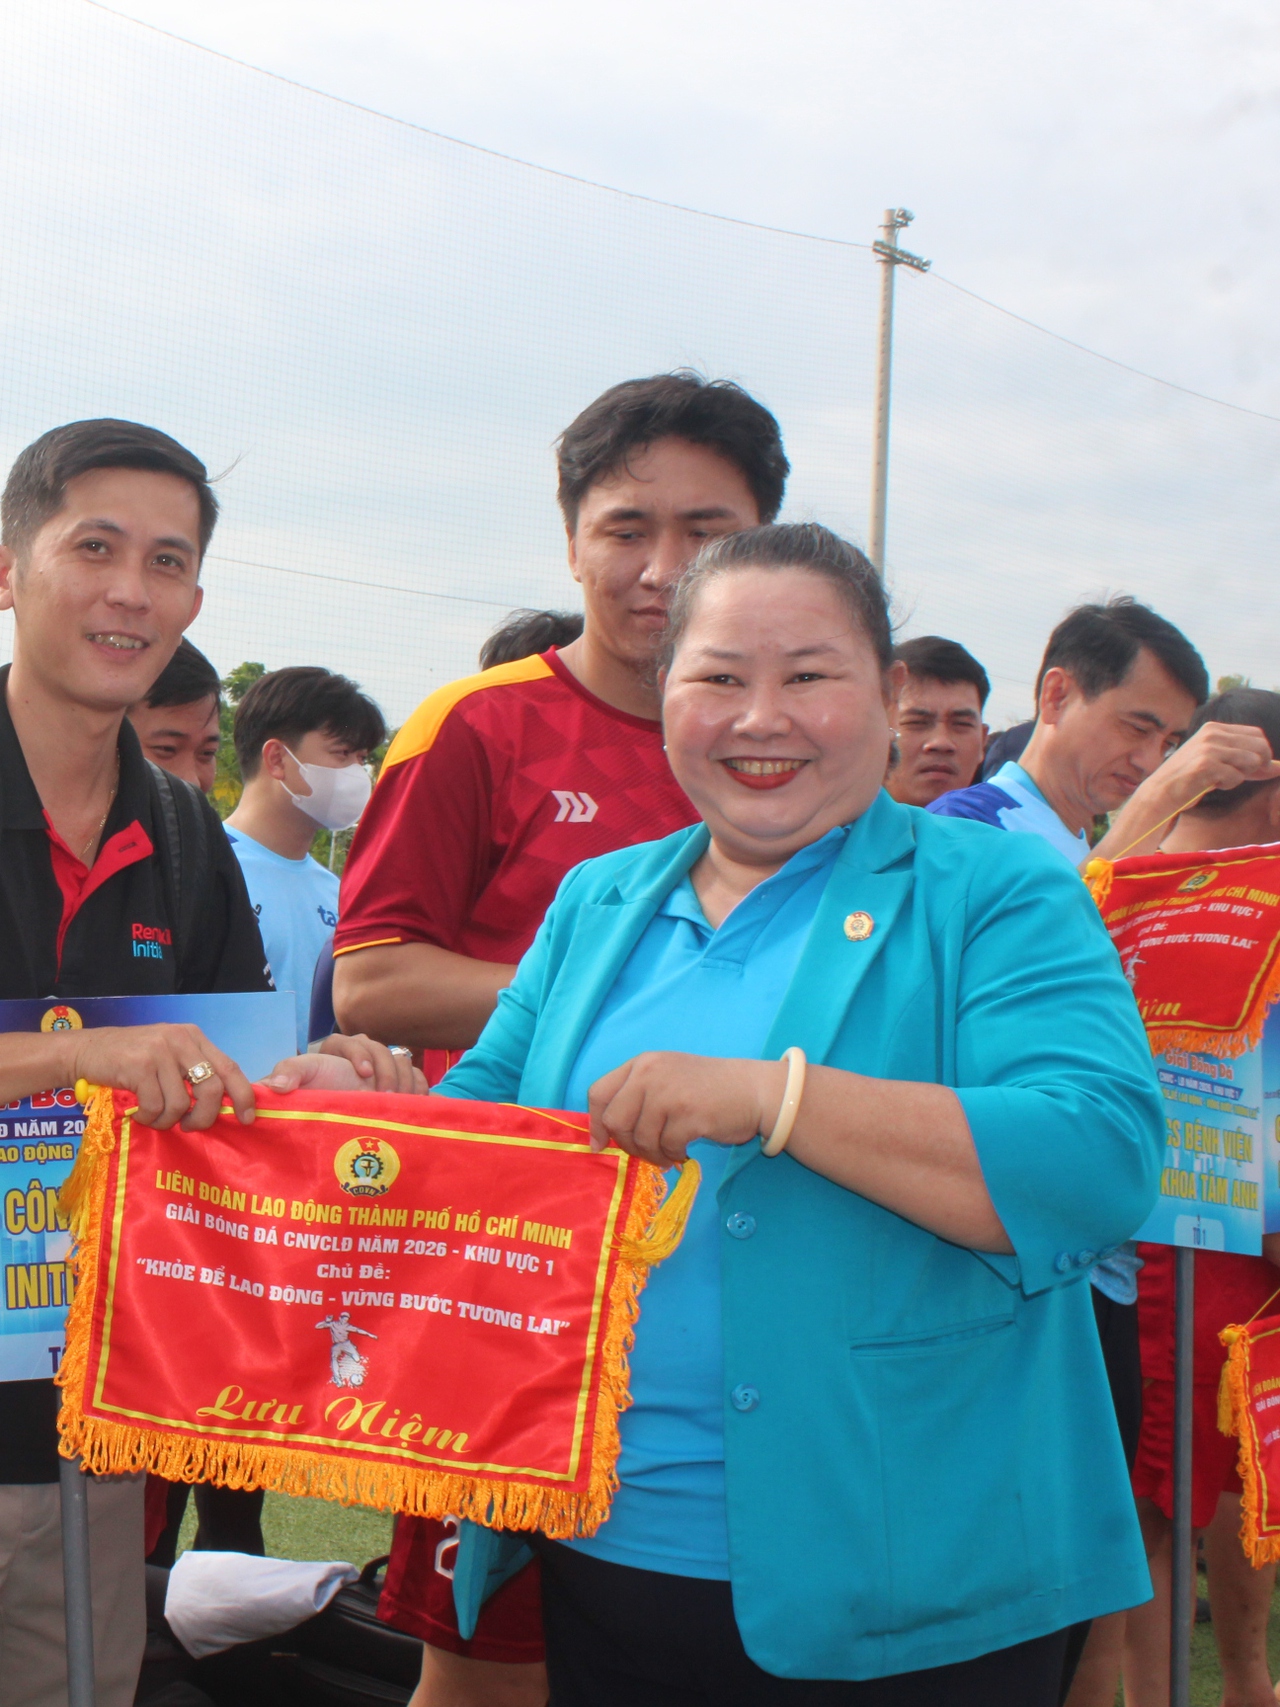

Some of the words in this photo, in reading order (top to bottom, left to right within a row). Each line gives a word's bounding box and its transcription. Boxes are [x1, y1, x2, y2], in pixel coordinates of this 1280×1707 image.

[15, 1118, 57, 1137] NĂM
[64, 1119, 88, 1135] 20
[1184, 1118, 1220, 1159] BỆNH
[1223, 1126, 1253, 1167] VIỆN
[23, 1144, 74, 1165] ĐỘNG
[4, 1178, 70, 1235] CÔN
[155, 1169, 195, 1197] LIÊN
[199, 1181, 246, 1212] ĐOÀN
[250, 1194, 286, 1218] LAO
[290, 1199, 342, 1226] ĐỘNG
[348, 1203, 408, 1227] THÀNH
[412, 1206, 453, 1230] PHỐ
[454, 1209, 481, 1233] HỒ
[485, 1214, 520, 1239] CHÍ
[521, 1220, 573, 1250] MINH
[1160, 1167, 1197, 1200] KHOA
[1199, 1168, 1228, 1205] TÂM
[1232, 1179, 1258, 1210] ANH
[166, 1203, 200, 1225] GIẢI
[204, 1213, 249, 1240] BÓNG
[253, 1225, 278, 1246] ĐÁ
[283, 1231, 353, 1253] CNVCLĐ
[358, 1234, 399, 1254] NĂM
[403, 1240, 447, 1257] 2026
[464, 1245, 501, 1265] KHU
[505, 1251, 540, 1274] VỰC
[545, 1259, 554, 1276] 1
[199, 1265, 225, 1287] ĐỂ
[229, 1275, 264, 1298] LAO
[269, 1285, 324, 1306] ĐỘNG
[341, 1288, 394, 1308] VỮNG
[399, 1293, 453, 1315] BƯỚC
[457, 1301, 522, 1330] TƯƠNG
[317, 1263, 352, 1279] Chủ
[359, 1263, 391, 1280] Đề:
[195, 1384, 305, 1425] Lưu
[324, 1396, 471, 1454] Niệm
